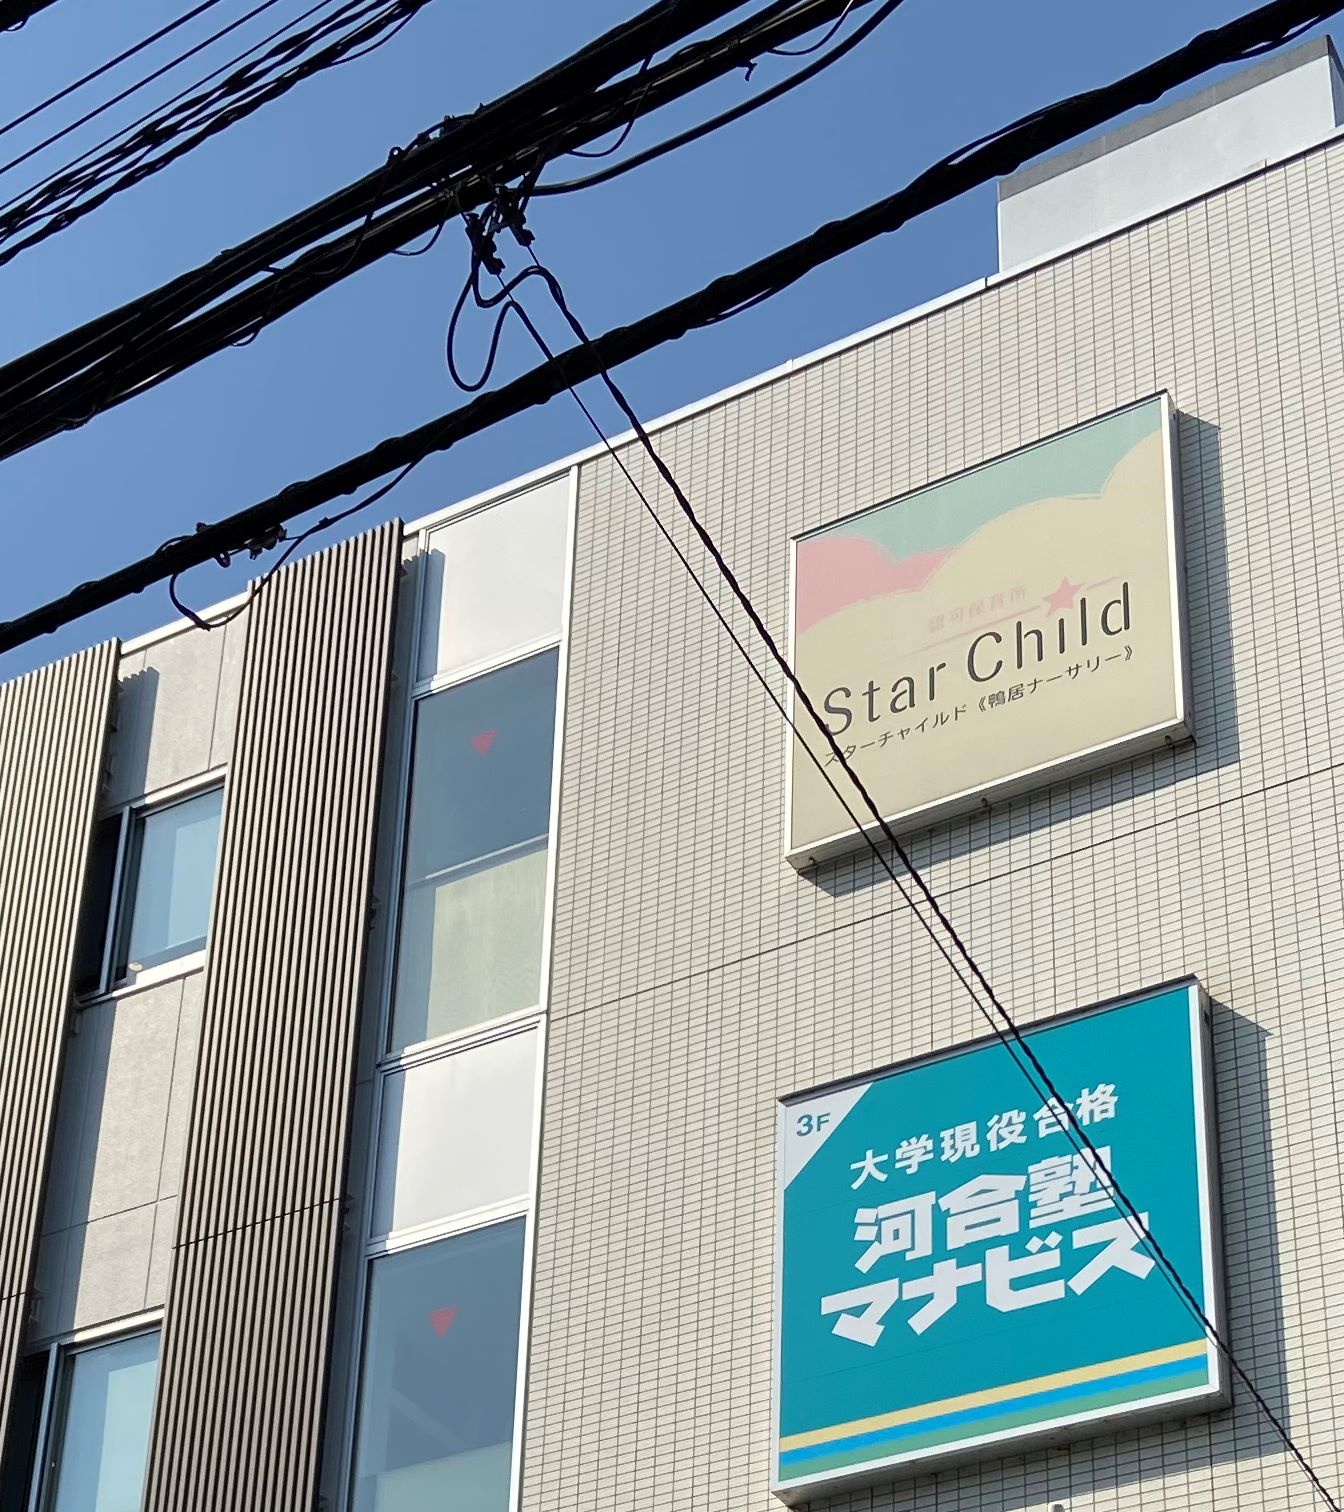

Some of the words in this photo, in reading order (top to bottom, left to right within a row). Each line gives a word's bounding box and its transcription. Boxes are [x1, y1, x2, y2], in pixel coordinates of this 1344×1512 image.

[823, 661, 947, 736] Star
[967, 581, 1132, 683] Child
[796, 1112, 831, 1138] 3F
[850, 1083, 1119, 1190] 大学現役合格
[854, 1145, 1116, 1274] 河合塾
[821, 1212, 1156, 1347] マナビス
